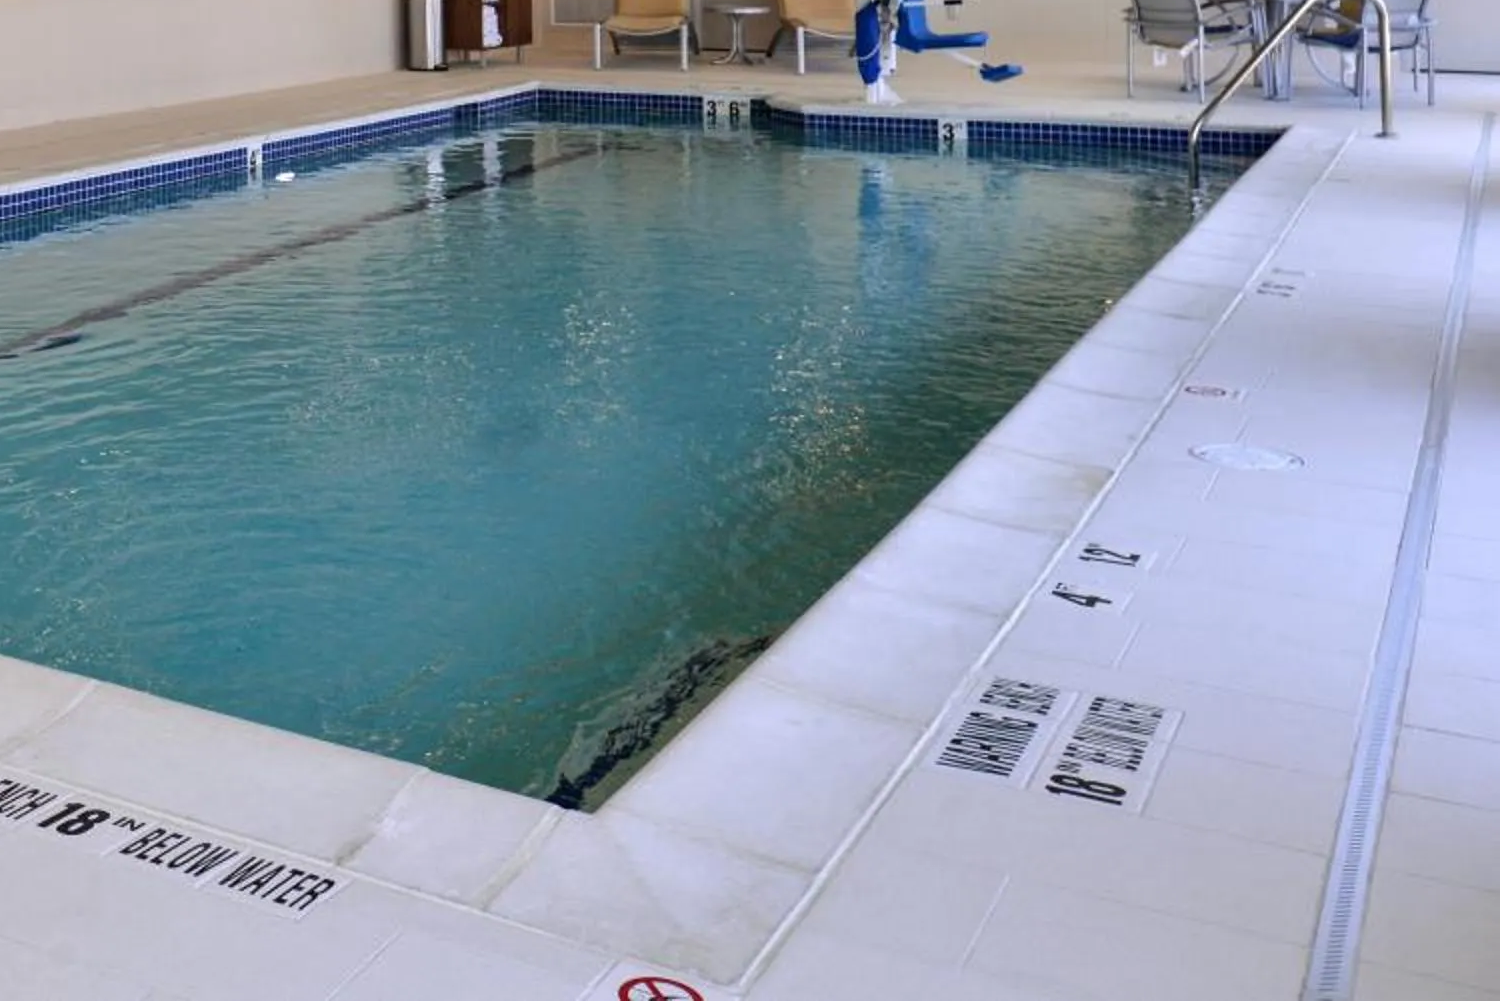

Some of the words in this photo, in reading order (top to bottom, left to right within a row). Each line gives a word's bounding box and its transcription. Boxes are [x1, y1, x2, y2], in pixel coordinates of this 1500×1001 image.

[707, 100, 717, 116] 3
[942, 122, 955, 141] 3
[934, 710, 1040, 778] WARNING
[1044, 774, 1128, 806] 18
[37, 802, 111, 837] 18
[112, 815, 146, 833] IN
[118, 827, 241, 878] BELOW
[218, 855, 337, 912] WATER
